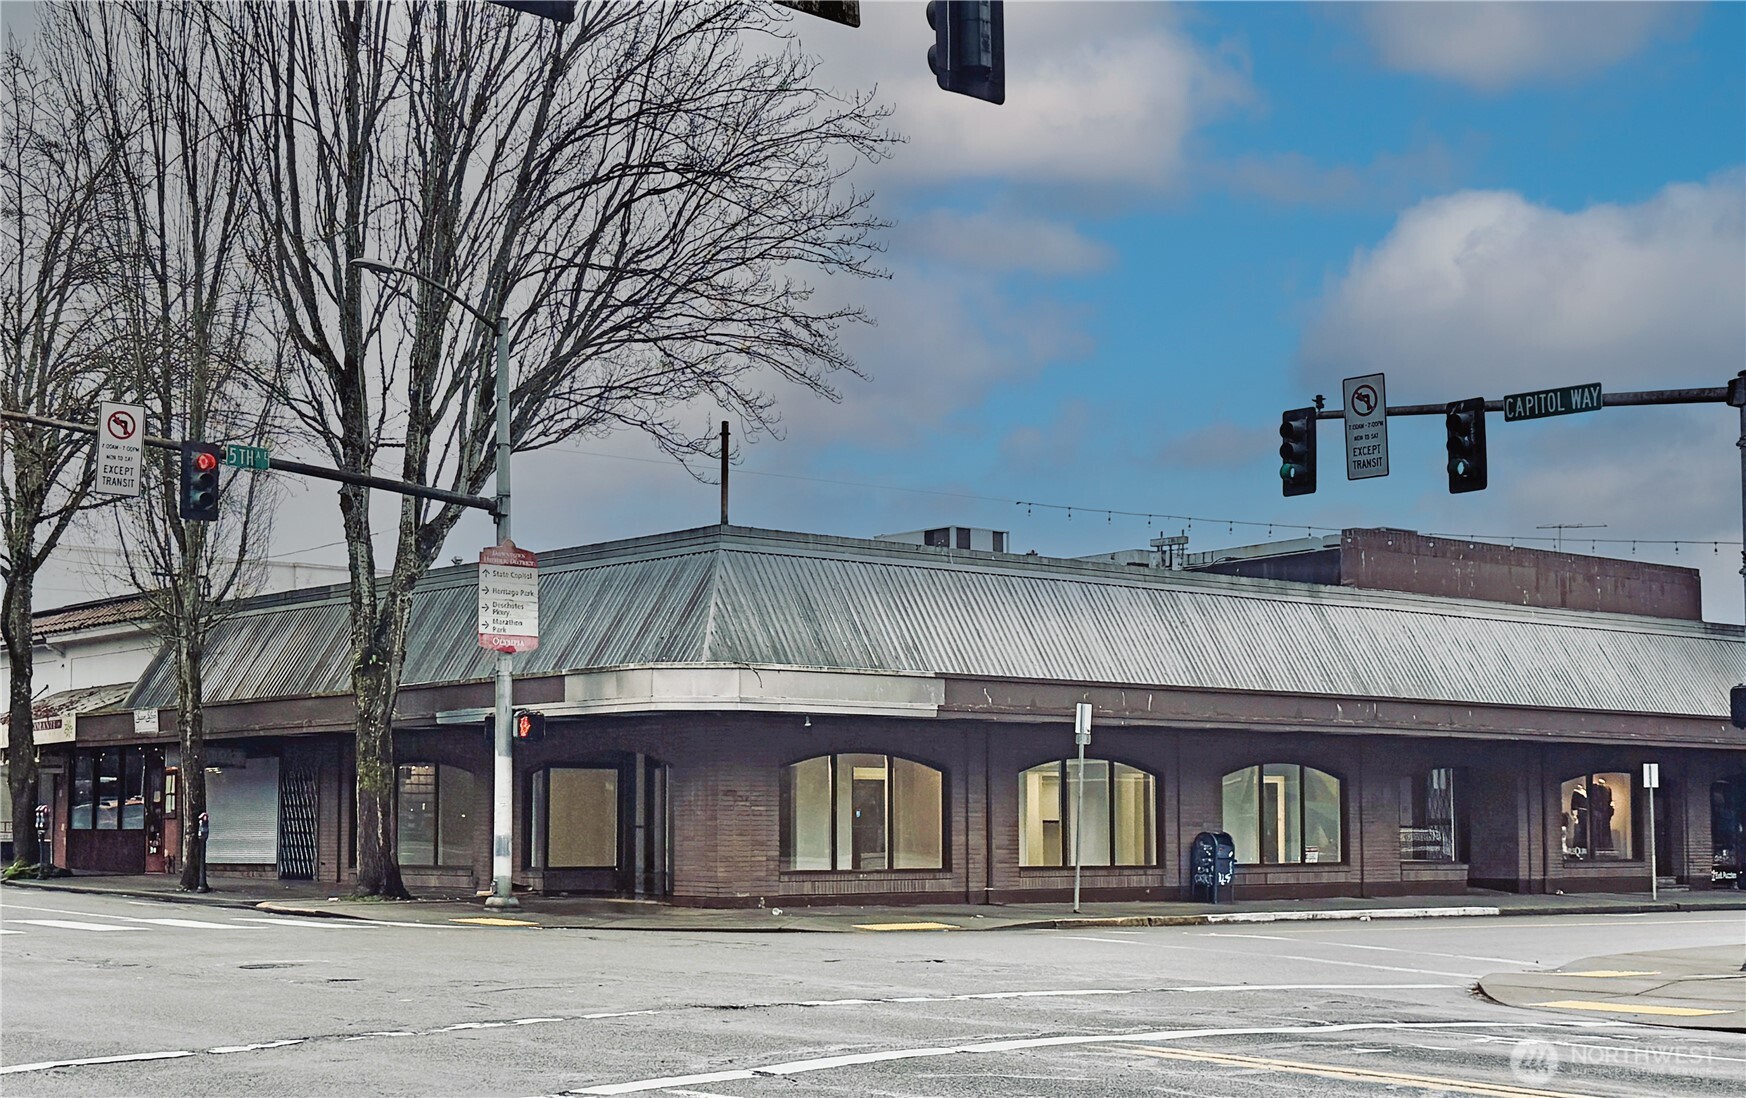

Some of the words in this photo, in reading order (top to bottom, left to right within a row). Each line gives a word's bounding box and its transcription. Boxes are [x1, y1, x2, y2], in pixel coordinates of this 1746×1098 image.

[1505, 391, 1565, 418] CAPITOL
[1570, 386, 1600, 410] WAY
[1371, 432, 1379, 440] SAT
[229, 447, 254, 466] 5TH
[1353, 444, 1381, 457] EXCEPT
[1352, 457, 1383, 470] TRANSIT
[103, 464, 134, 477] EXCEPT
[102, 475, 135, 488] TRANSIT
[492, 570, 509, 578] State
[492, 587, 519, 597] Heritage
[520, 589, 534, 597] Park
[492, 601, 524, 610] Deschutes
[492, 618, 523, 626] Marathon
